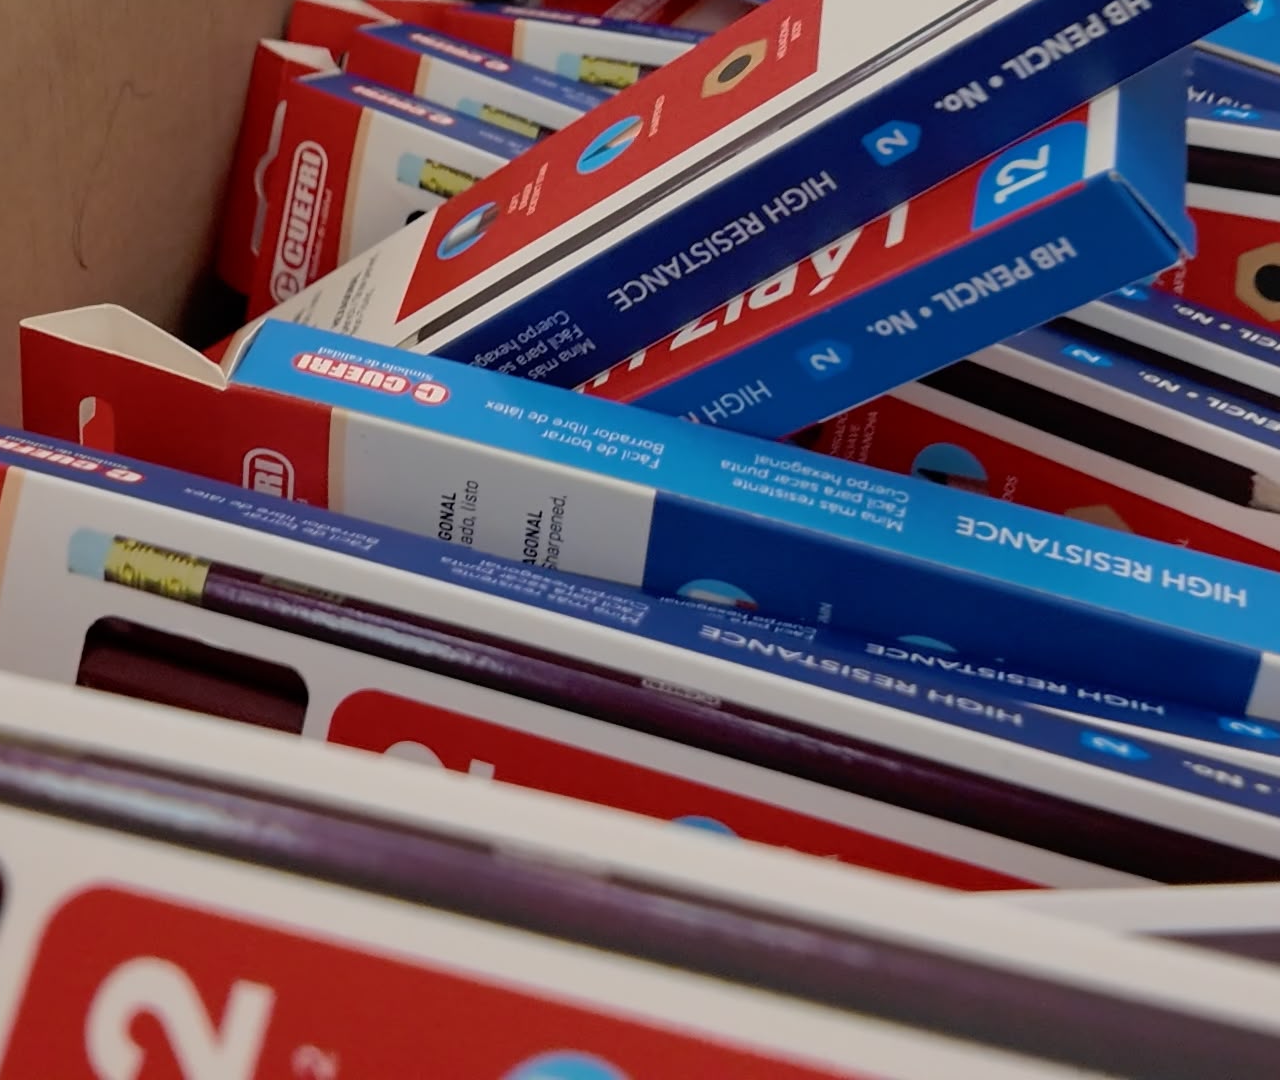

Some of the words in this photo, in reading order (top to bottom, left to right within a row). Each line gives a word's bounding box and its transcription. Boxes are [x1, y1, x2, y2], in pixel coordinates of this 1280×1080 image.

[999, 12, 1111, 83] PENCIL
[930, 79, 994, 121] No.
[867, 128, 913, 156] 2
[988, 141, 1051, 205] 12
[281, 148, 324, 262] CUEFRI
[757, 169, 839, 223] HIGH
[607, 217, 766, 311] RESISTANCE
[1030, 235, 1073, 270] HB
[933, 254, 1033, 312] PENCIL
[517, 309, 571, 342] Cuerpo
[867, 308, 923, 341] No.
[1172, 302, 1213, 326] No.
[549, 324, 585, 348] Fácil
[561, 338, 597, 361] Mina
[316, 344, 363, 363] calidad
[363, 356, 379, 368] de
[468, 337, 521, 368] hexag
[512, 343, 547, 364] para
[805, 347, 843, 370] 2
[296, 352, 408, 394] CUEFRI
[528, 358, 562, 379] más
[1136, 369, 1181, 395] No.
[705, 378, 776, 418] HIGH
[526, 409, 547, 424] de
[548, 414, 589, 435] libre
[539, 428, 593, 452] borrar
[590, 425, 665, 454] Borrador
[594, 442, 617, 458] de
[619, 448, 661, 469] Fácil
[719, 455, 773, 482] punta
[753, 450, 842, 486] hexagonal
[459, 479, 480, 514] listo
[730, 476, 814, 509] resistente
[773, 471, 820, 494] sacar
[821, 481, 862, 504] para
[843, 473, 909, 503] Cuerpo
[242, 511, 294, 529] borrar
[439, 491, 458, 542] GONAL
[816, 498, 856, 520] más
[866, 494, 907, 517] Fácil
[459, 515, 477, 550] ado,
[859, 509, 904, 532] Mina
[521, 508, 544, 570] AGONAL
[954, 514, 1152, 582] RESISTANCE
[446, 566, 540, 596] resistente
[1160, 567, 1247, 608] HIGH
[590, 605, 641, 625] Mina
[694, 624, 920, 696] RESISTANCE
[864, 642, 1067, 694] RESISTANCE
[927, 689, 1025, 725] HIGH
[1076, 688, 1164, 715] HIGH
[1180, 760, 1243, 789] No.
